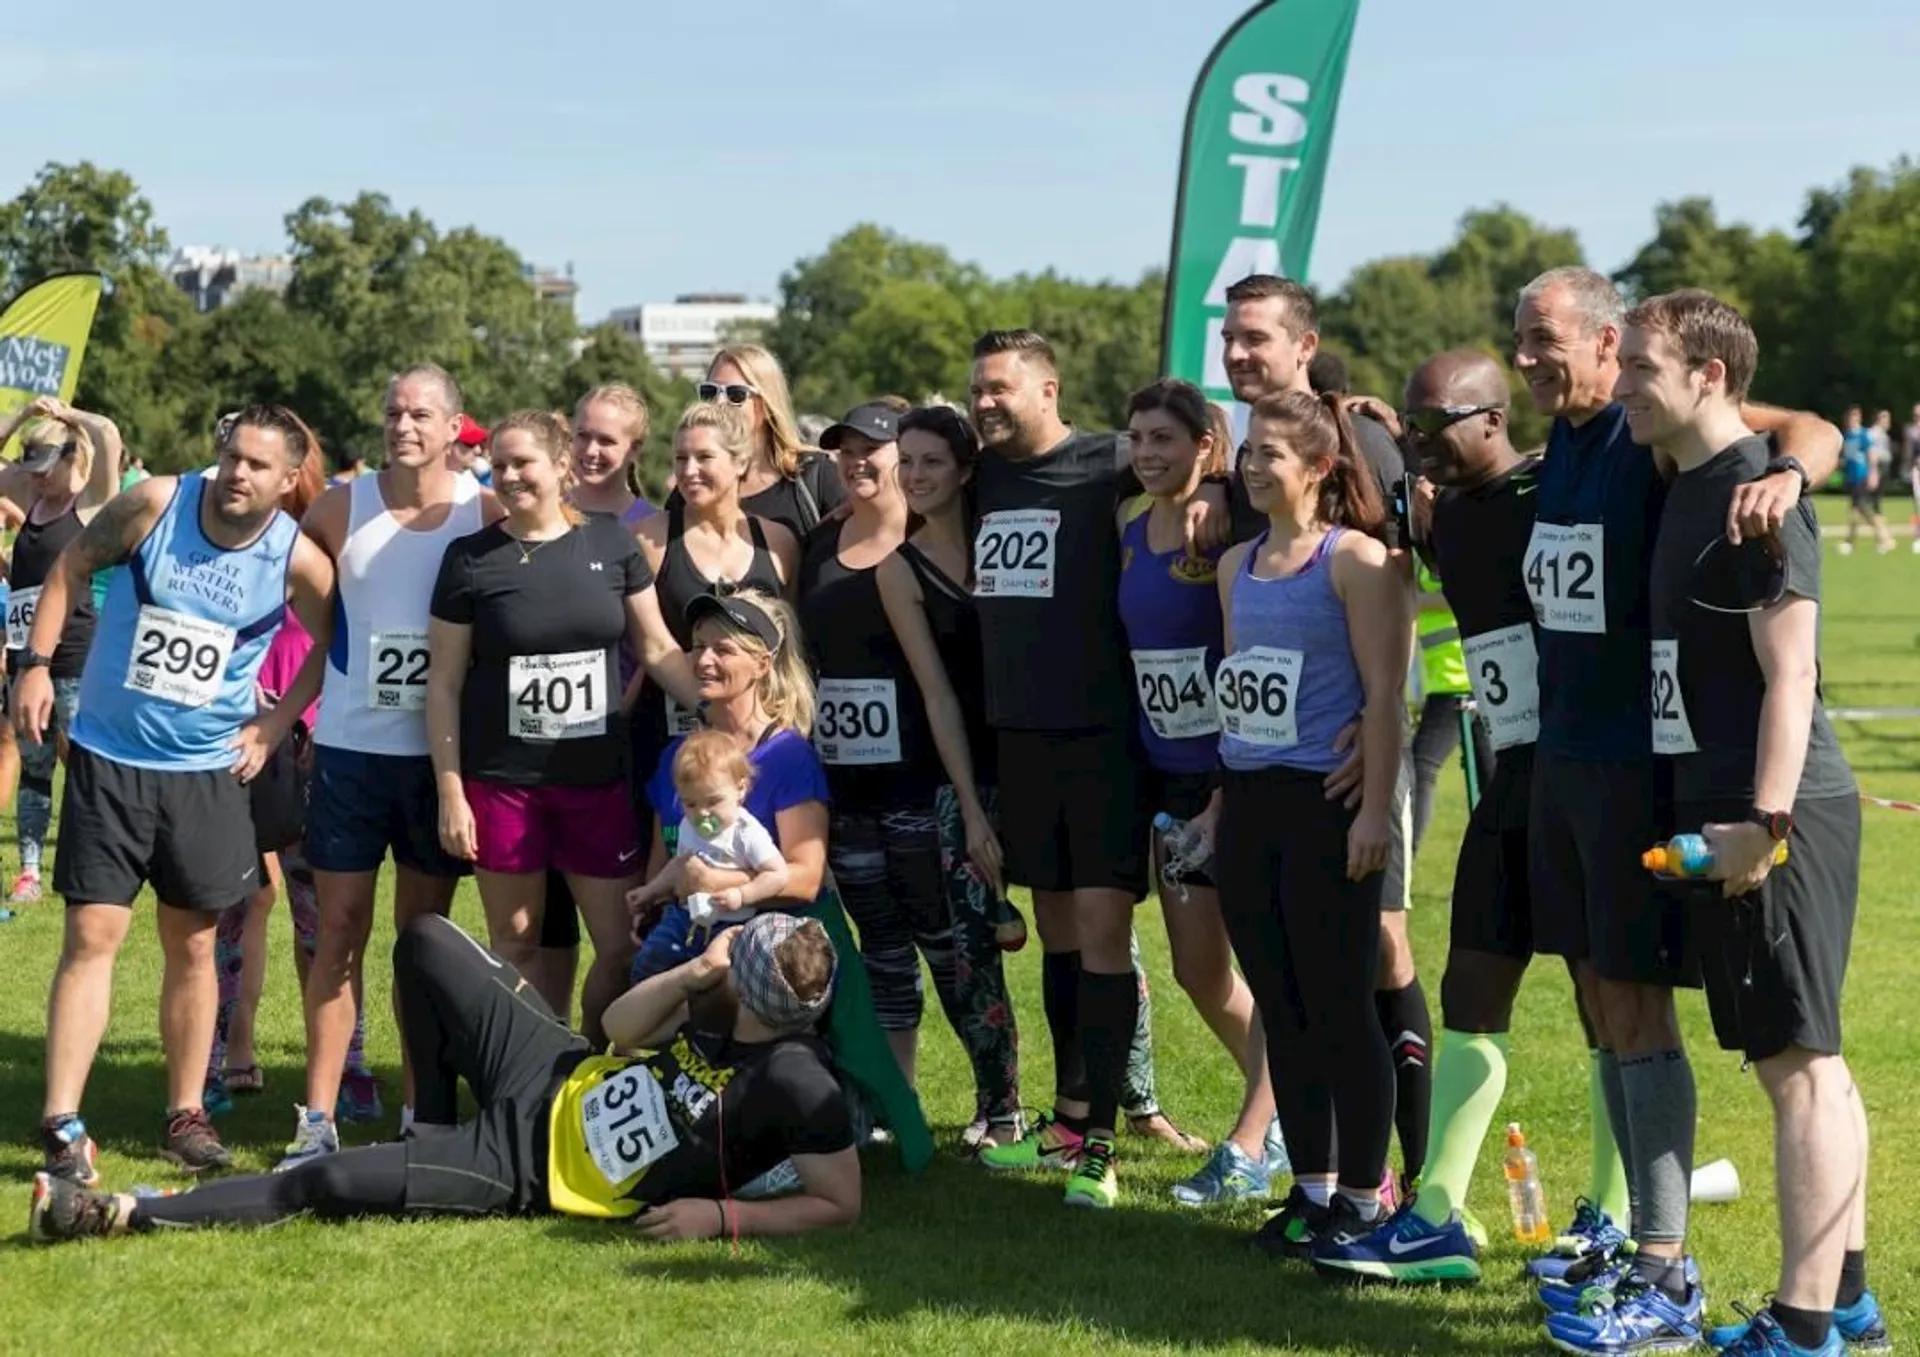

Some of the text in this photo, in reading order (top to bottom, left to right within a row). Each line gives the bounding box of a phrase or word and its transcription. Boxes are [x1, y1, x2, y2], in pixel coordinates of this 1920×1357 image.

[188, 550, 240, 578] GREAT
[980, 530, 1048, 570] 202
[167, 577, 239, 614] RUNNERS
[172, 563, 243, 598] WESTERN
[1528, 550, 1595, 600] 412
[136, 628, 220, 682] 299
[376, 647, 431, 685] 22
[517, 673, 593, 714] 401
[1141, 671, 1206, 714] 204
[1219, 667, 1289, 717] 366
[1481, 660, 1508, 706] 3
[818, 700, 889, 738] 330
[603, 1075, 655, 1164] 315
